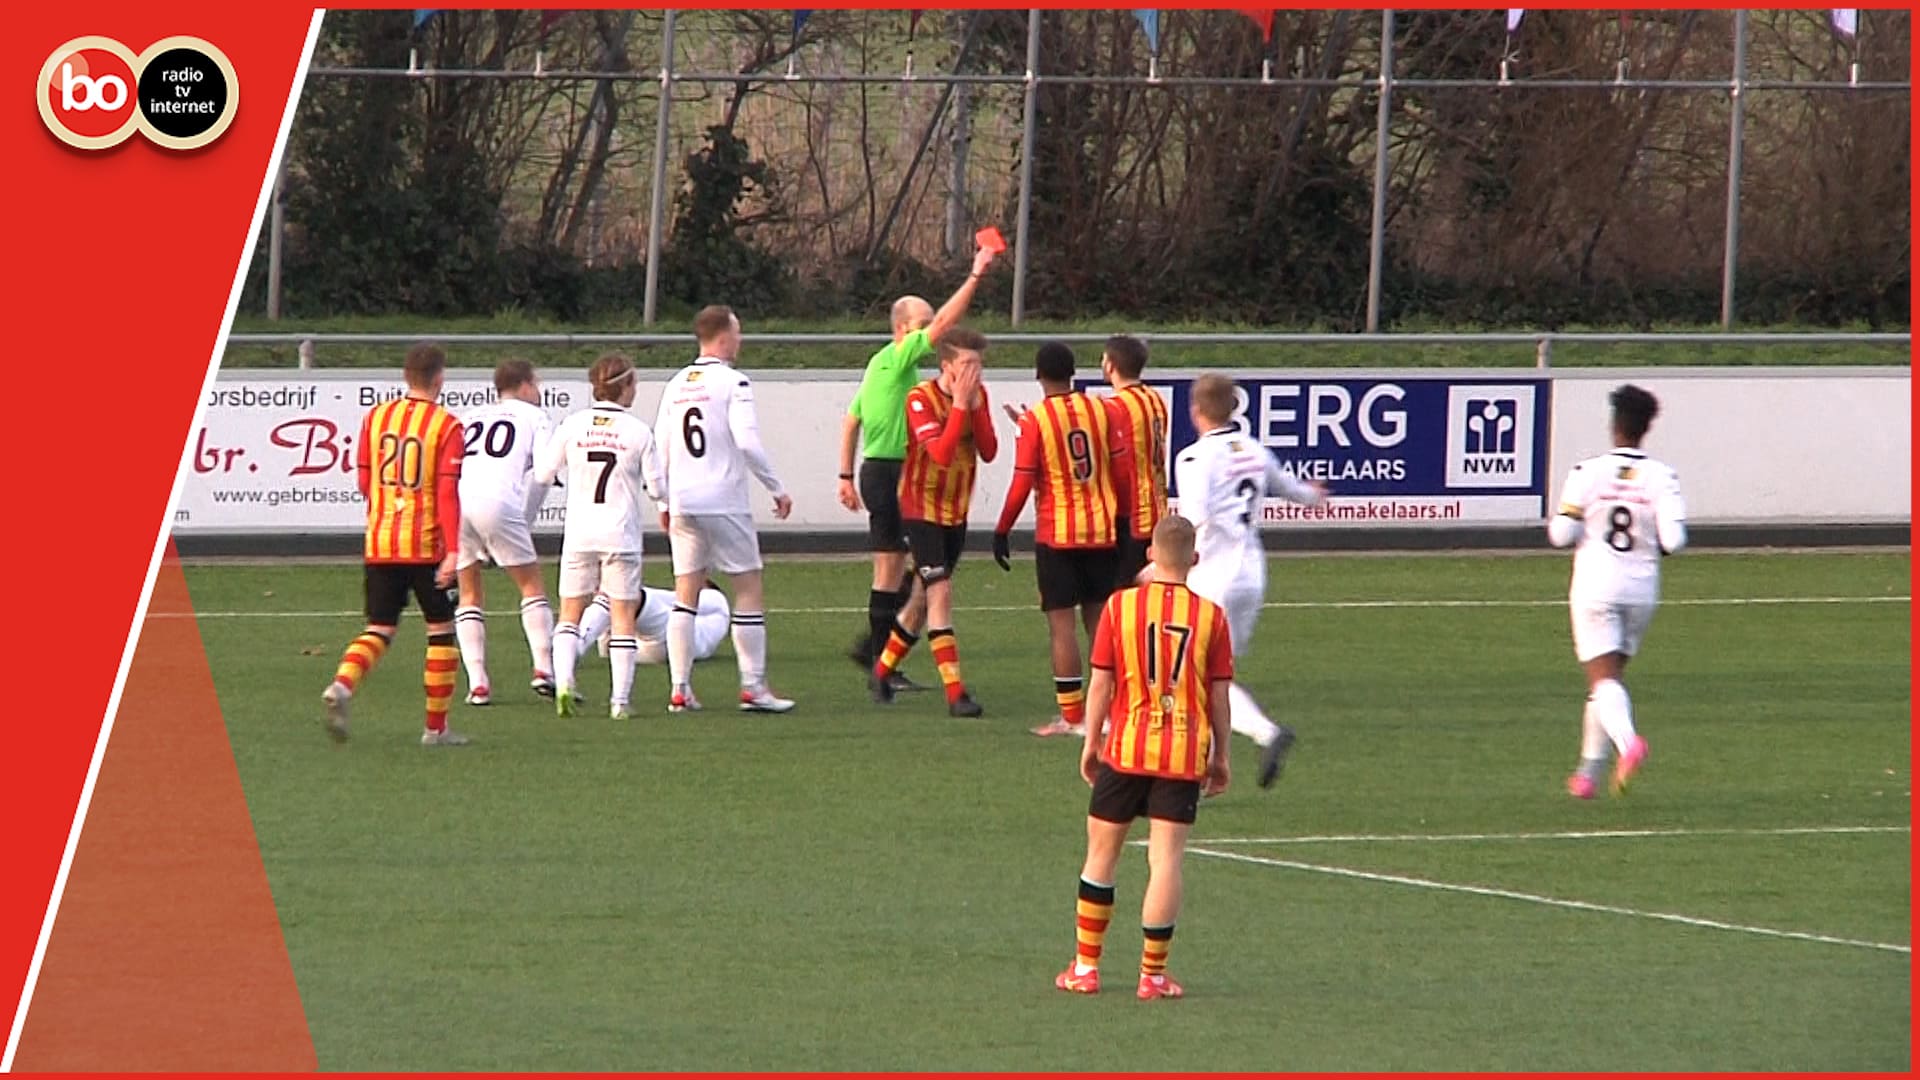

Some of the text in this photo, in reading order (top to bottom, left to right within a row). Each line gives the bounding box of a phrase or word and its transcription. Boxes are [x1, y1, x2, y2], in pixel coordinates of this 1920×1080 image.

[464, 420, 516, 458] 20
[683, 406, 706, 458] 6
[1067, 429, 1092, 481] 9
[379, 433, 423, 488] 20
[587, 451, 617, 504] 7
[1278, 459, 1405, 480] AKELAARS
[1463, 458, 1515, 473] NVM
[213, 487, 366, 506] www.gebrbissc
[1605, 505, 1633, 552] 8
[1147, 621, 1192, 686] 17
